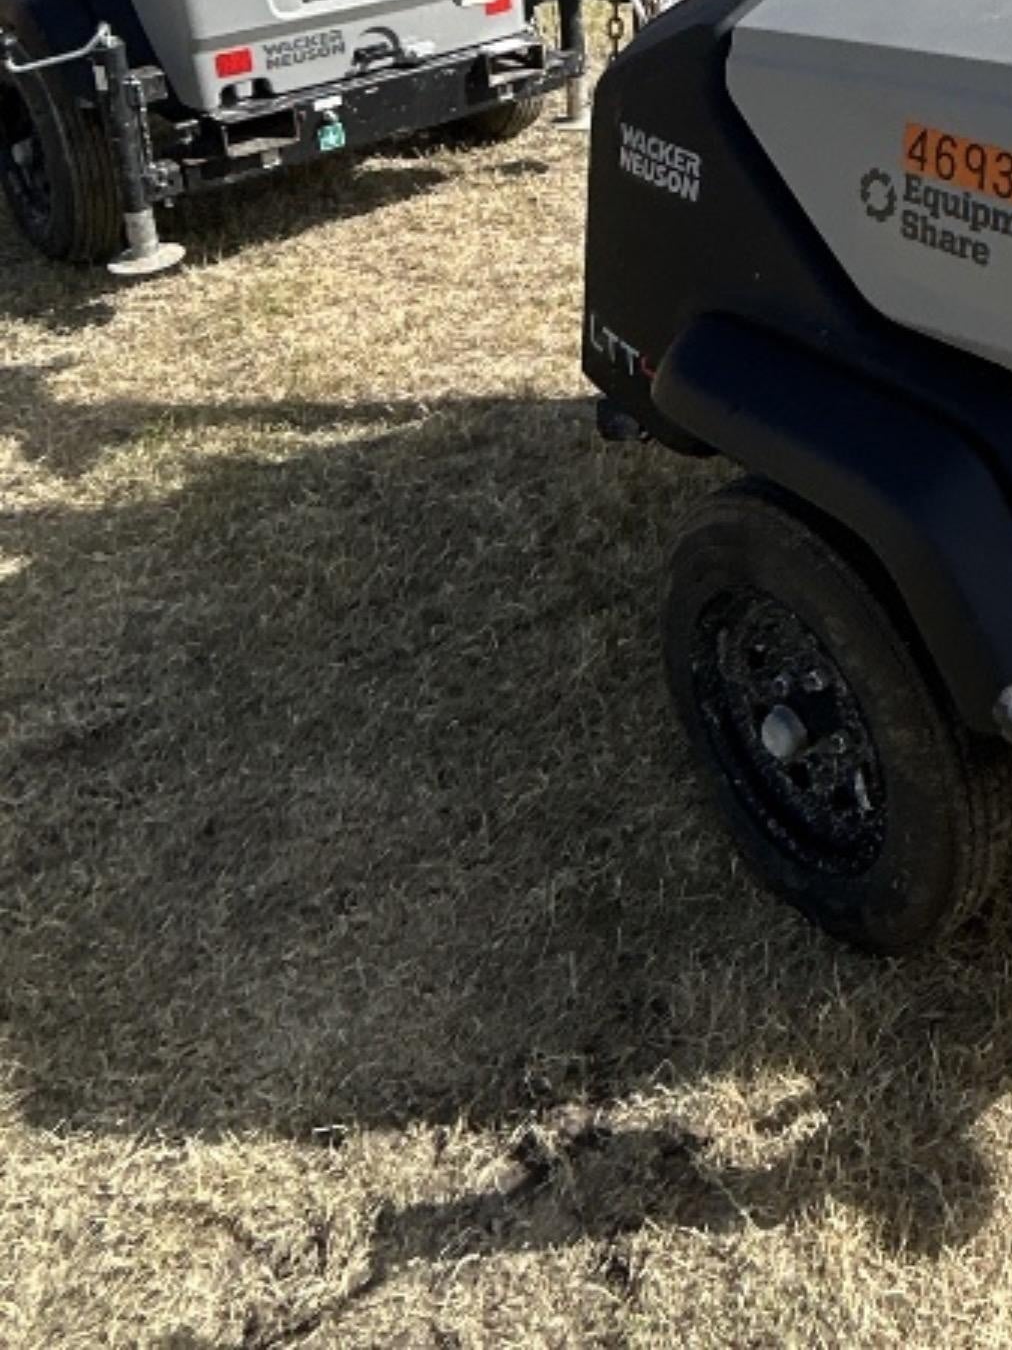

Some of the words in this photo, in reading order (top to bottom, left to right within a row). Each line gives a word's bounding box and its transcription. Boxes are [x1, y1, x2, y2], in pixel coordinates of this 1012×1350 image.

[620, 121, 702, 179] WACKER
[620, 145, 701, 203] NEUSON
[901, 209, 991, 268] Share
